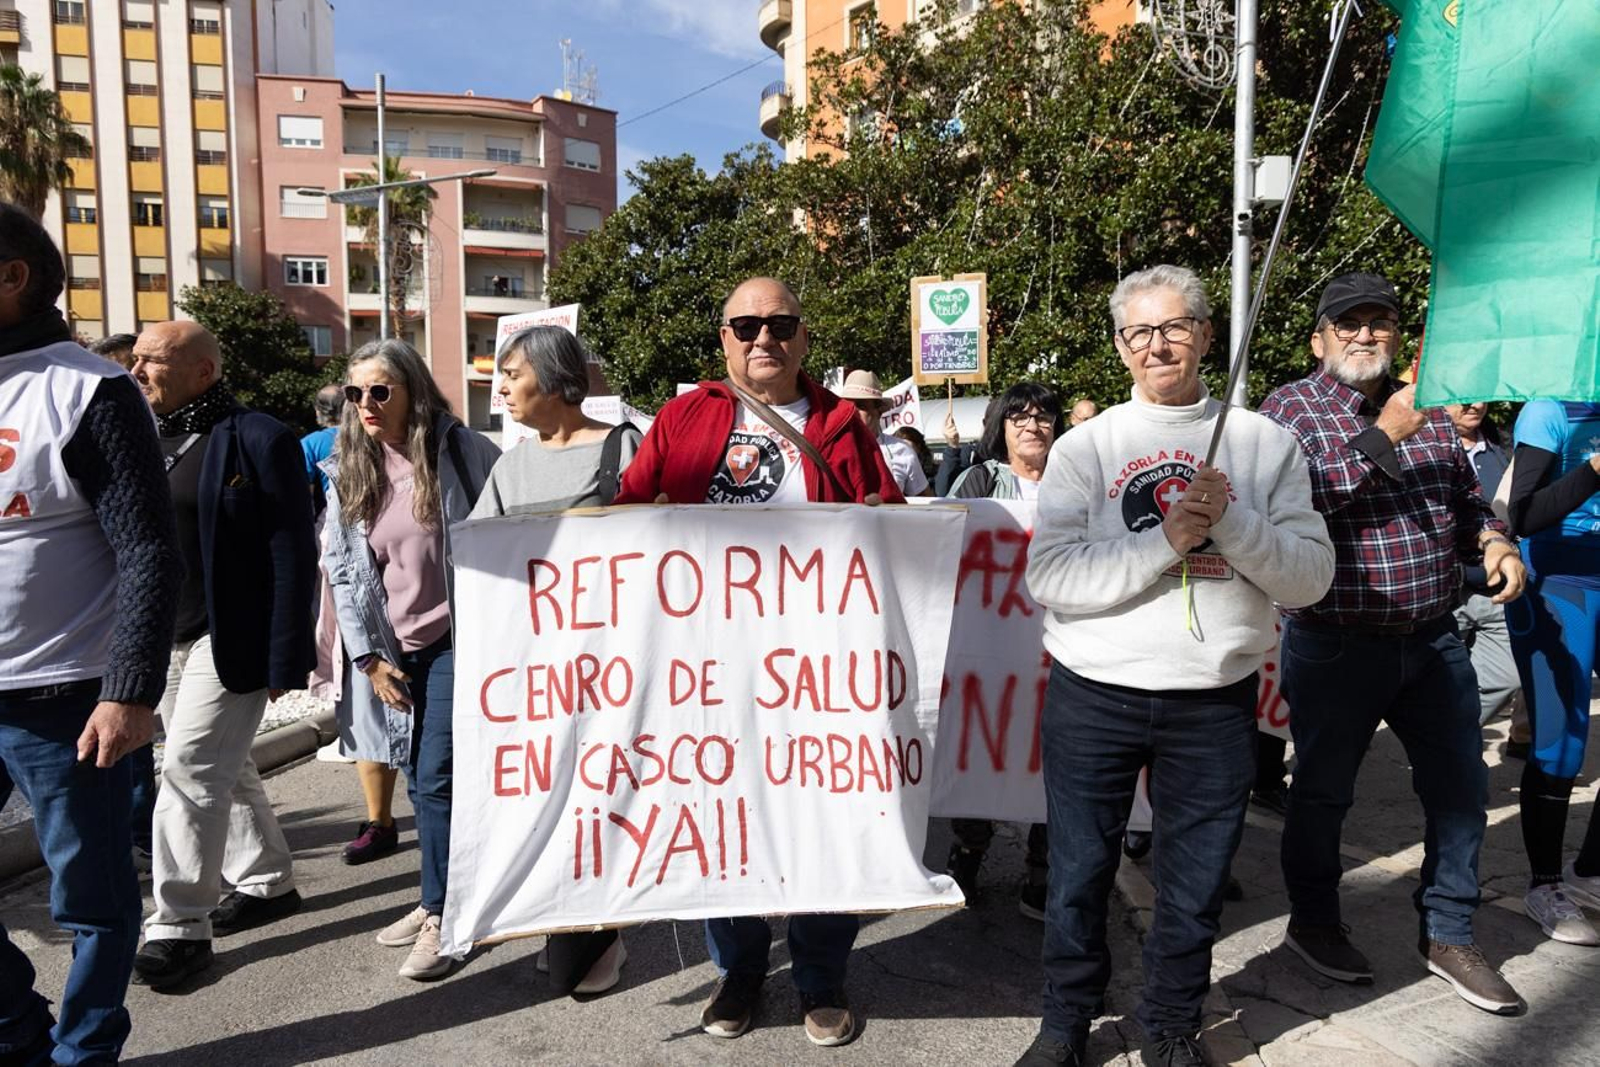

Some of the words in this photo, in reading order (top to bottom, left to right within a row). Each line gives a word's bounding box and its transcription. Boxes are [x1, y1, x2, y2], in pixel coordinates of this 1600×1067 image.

[890, 390, 915, 409] DA
[708, 484, 770, 504] CAZORLA
[1109, 450, 1169, 500] CAZORLA
[1173, 450, 1195, 464] EN
[1129, 466, 1172, 494] SANIDAD
[0, 490, 31, 517] A
[527, 545, 880, 636] REFORMA
[479, 652, 634, 723] CENRO
[669, 658, 724, 707] DE
[756, 648, 907, 712] SALUD
[494, 735, 552, 797] EN
[579, 734, 735, 796] CASCO
[765, 733, 923, 794] URBANO
